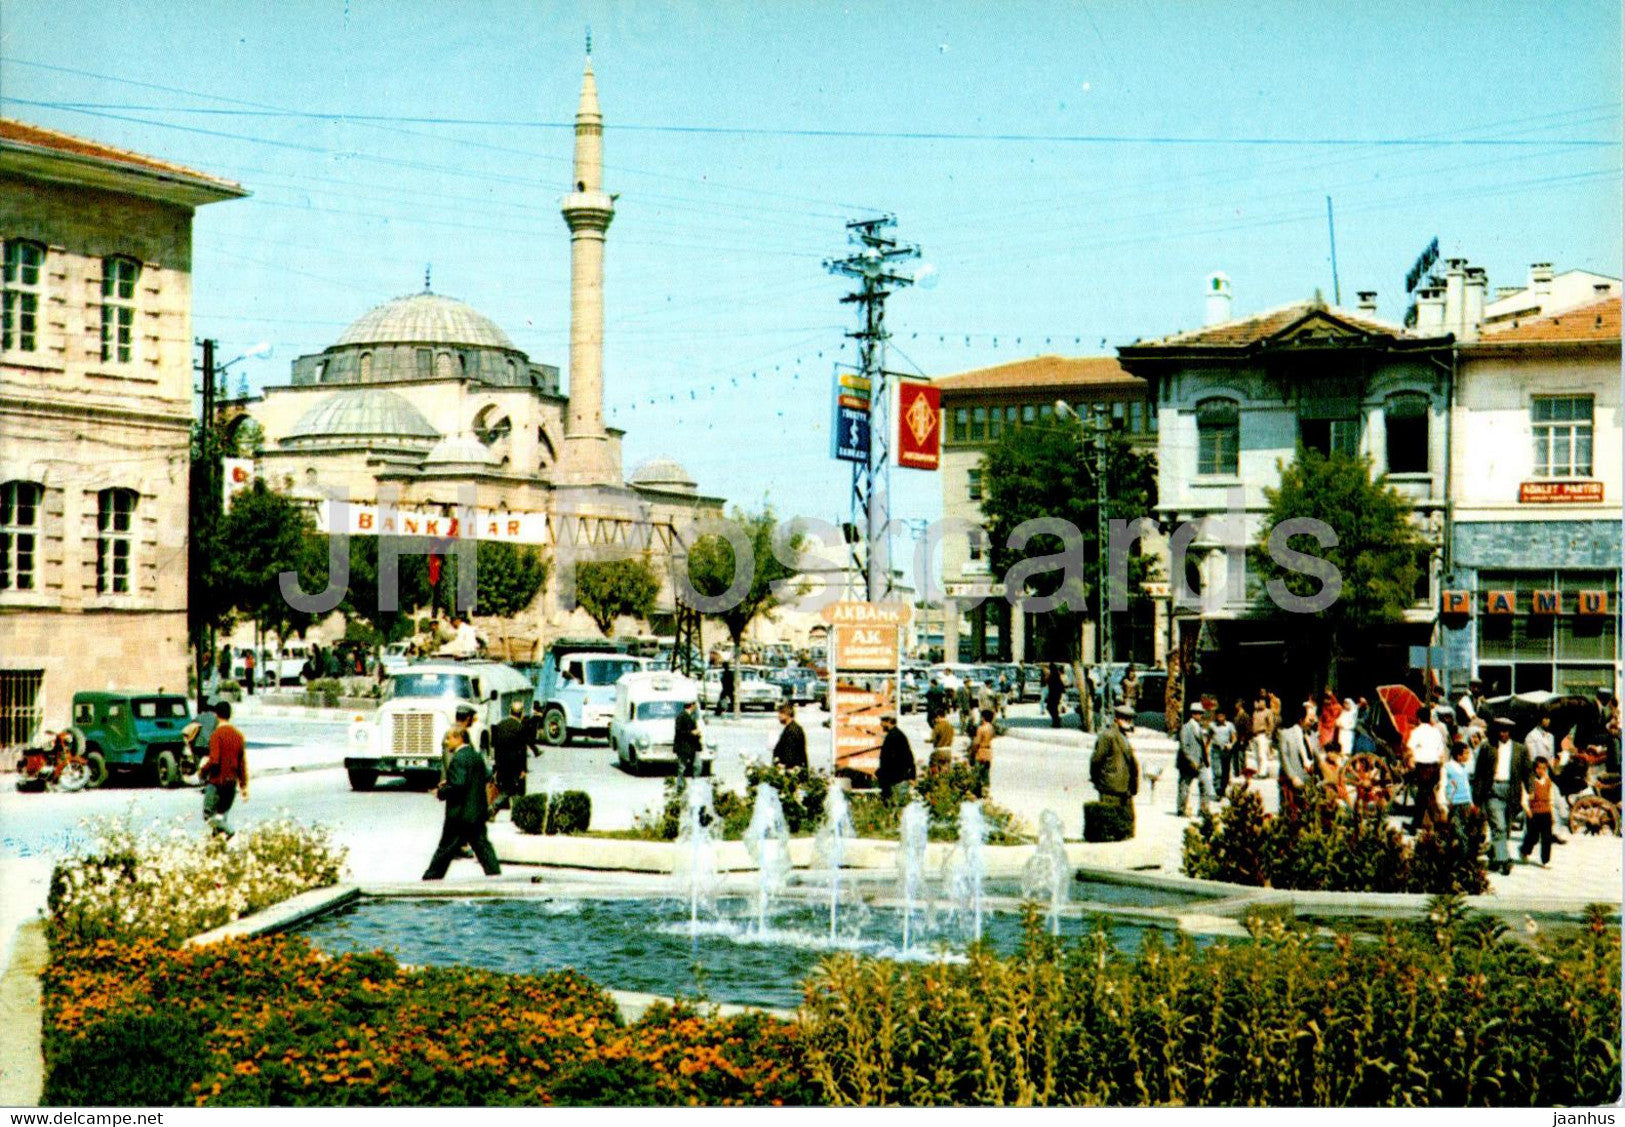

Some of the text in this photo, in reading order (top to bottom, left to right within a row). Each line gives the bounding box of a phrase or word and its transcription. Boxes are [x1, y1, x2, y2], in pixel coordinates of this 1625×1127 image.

[358, 512, 521, 537] BANKLAR
[833, 604, 900, 621] AKBANK
[851, 629, 882, 645] AK
